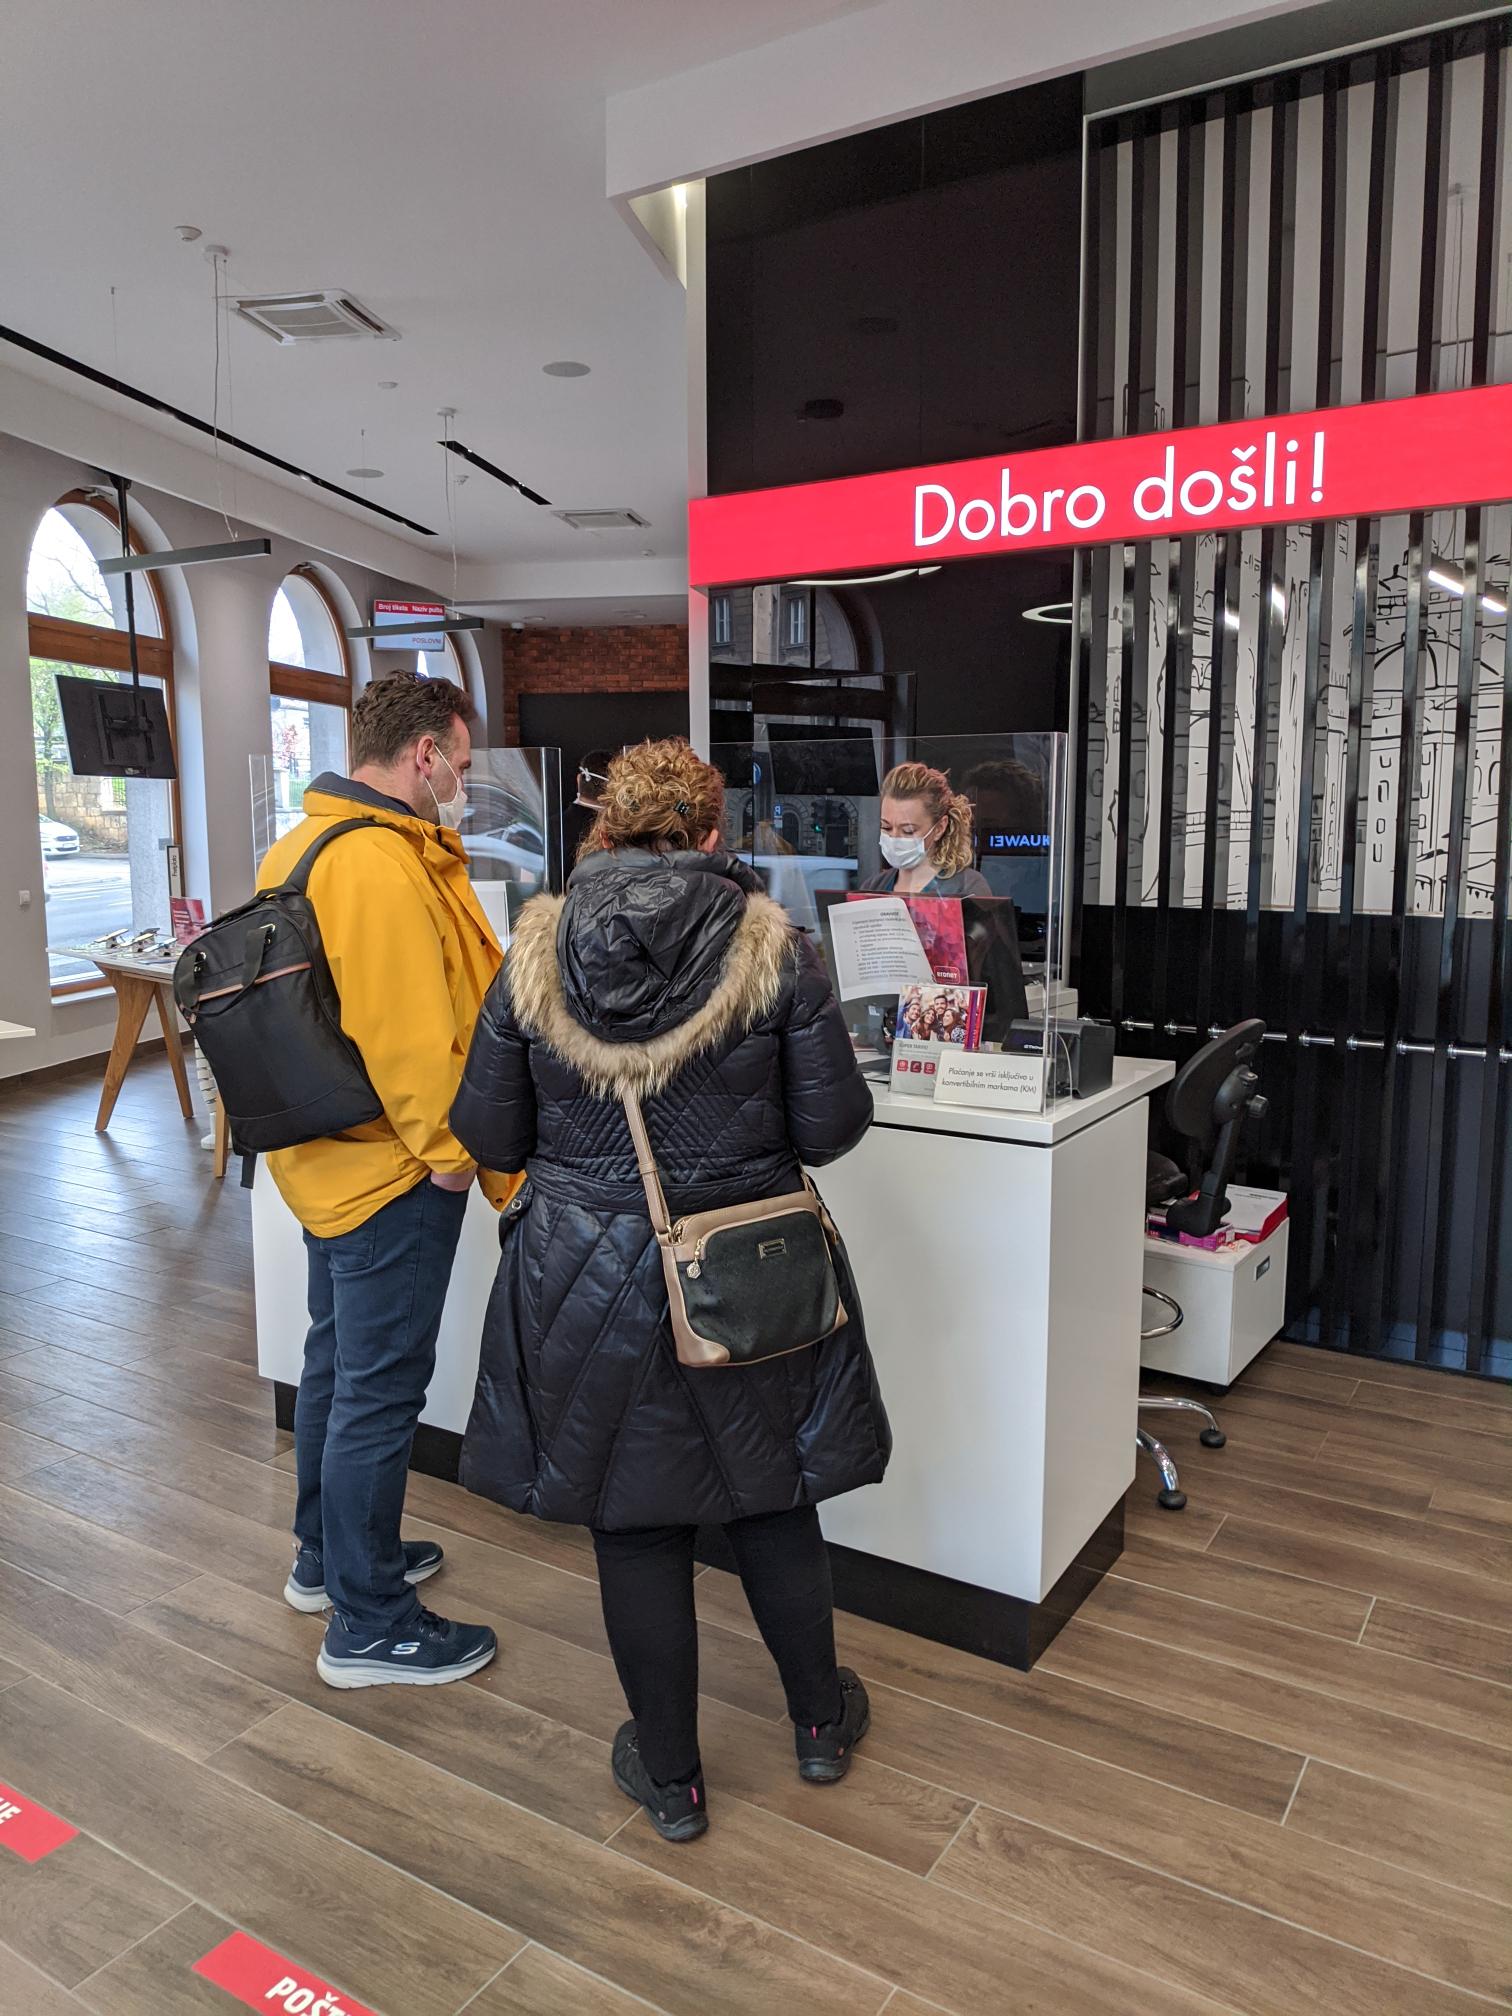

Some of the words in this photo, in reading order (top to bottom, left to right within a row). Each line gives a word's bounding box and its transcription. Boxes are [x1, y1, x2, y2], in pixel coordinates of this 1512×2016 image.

[915, 468, 1106, 547] Dobro
[1133, 431, 1326, 521] došli!
[378, 603, 391, 612] Broj
[412, 605, 427, 613] Naziv
[948, 1067, 975, 1077] Plaćanje
[998, 1070, 1028, 1080] isključivo
[942, 1077, 986, 1089] konvertibilnim
[987, 1082, 1019, 1092] markama
[1020, 1084, 1037, 1094] (KM)
